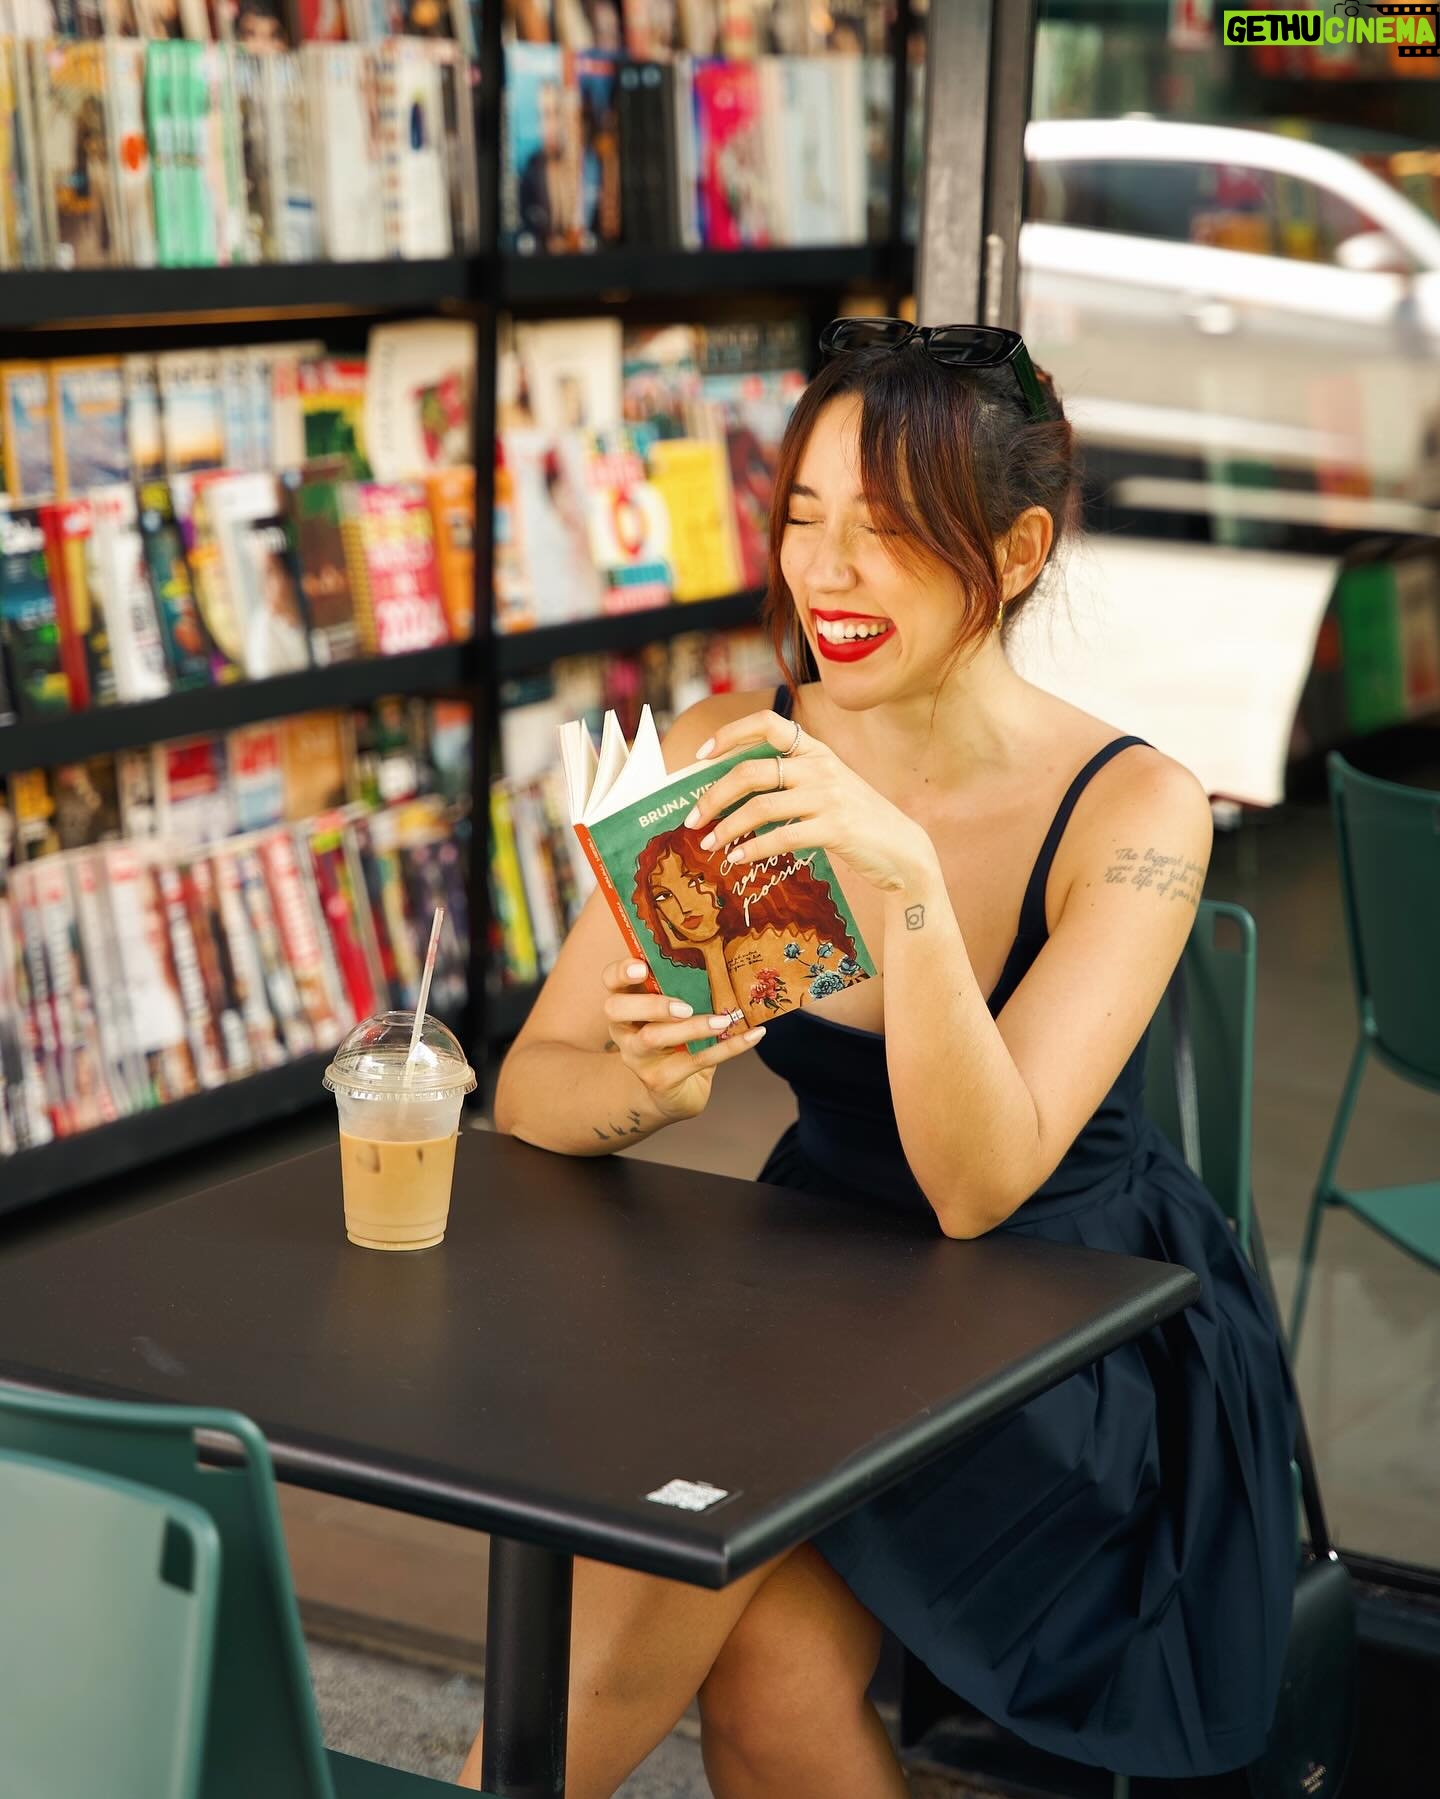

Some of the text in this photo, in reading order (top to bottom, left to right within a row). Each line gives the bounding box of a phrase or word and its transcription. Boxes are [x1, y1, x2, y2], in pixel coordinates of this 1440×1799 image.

[638, 796, 690, 828] BRUNA
[1115, 848, 1138, 861] The
[732, 852, 787, 896] viro
[743, 851, 817, 927] poesia
